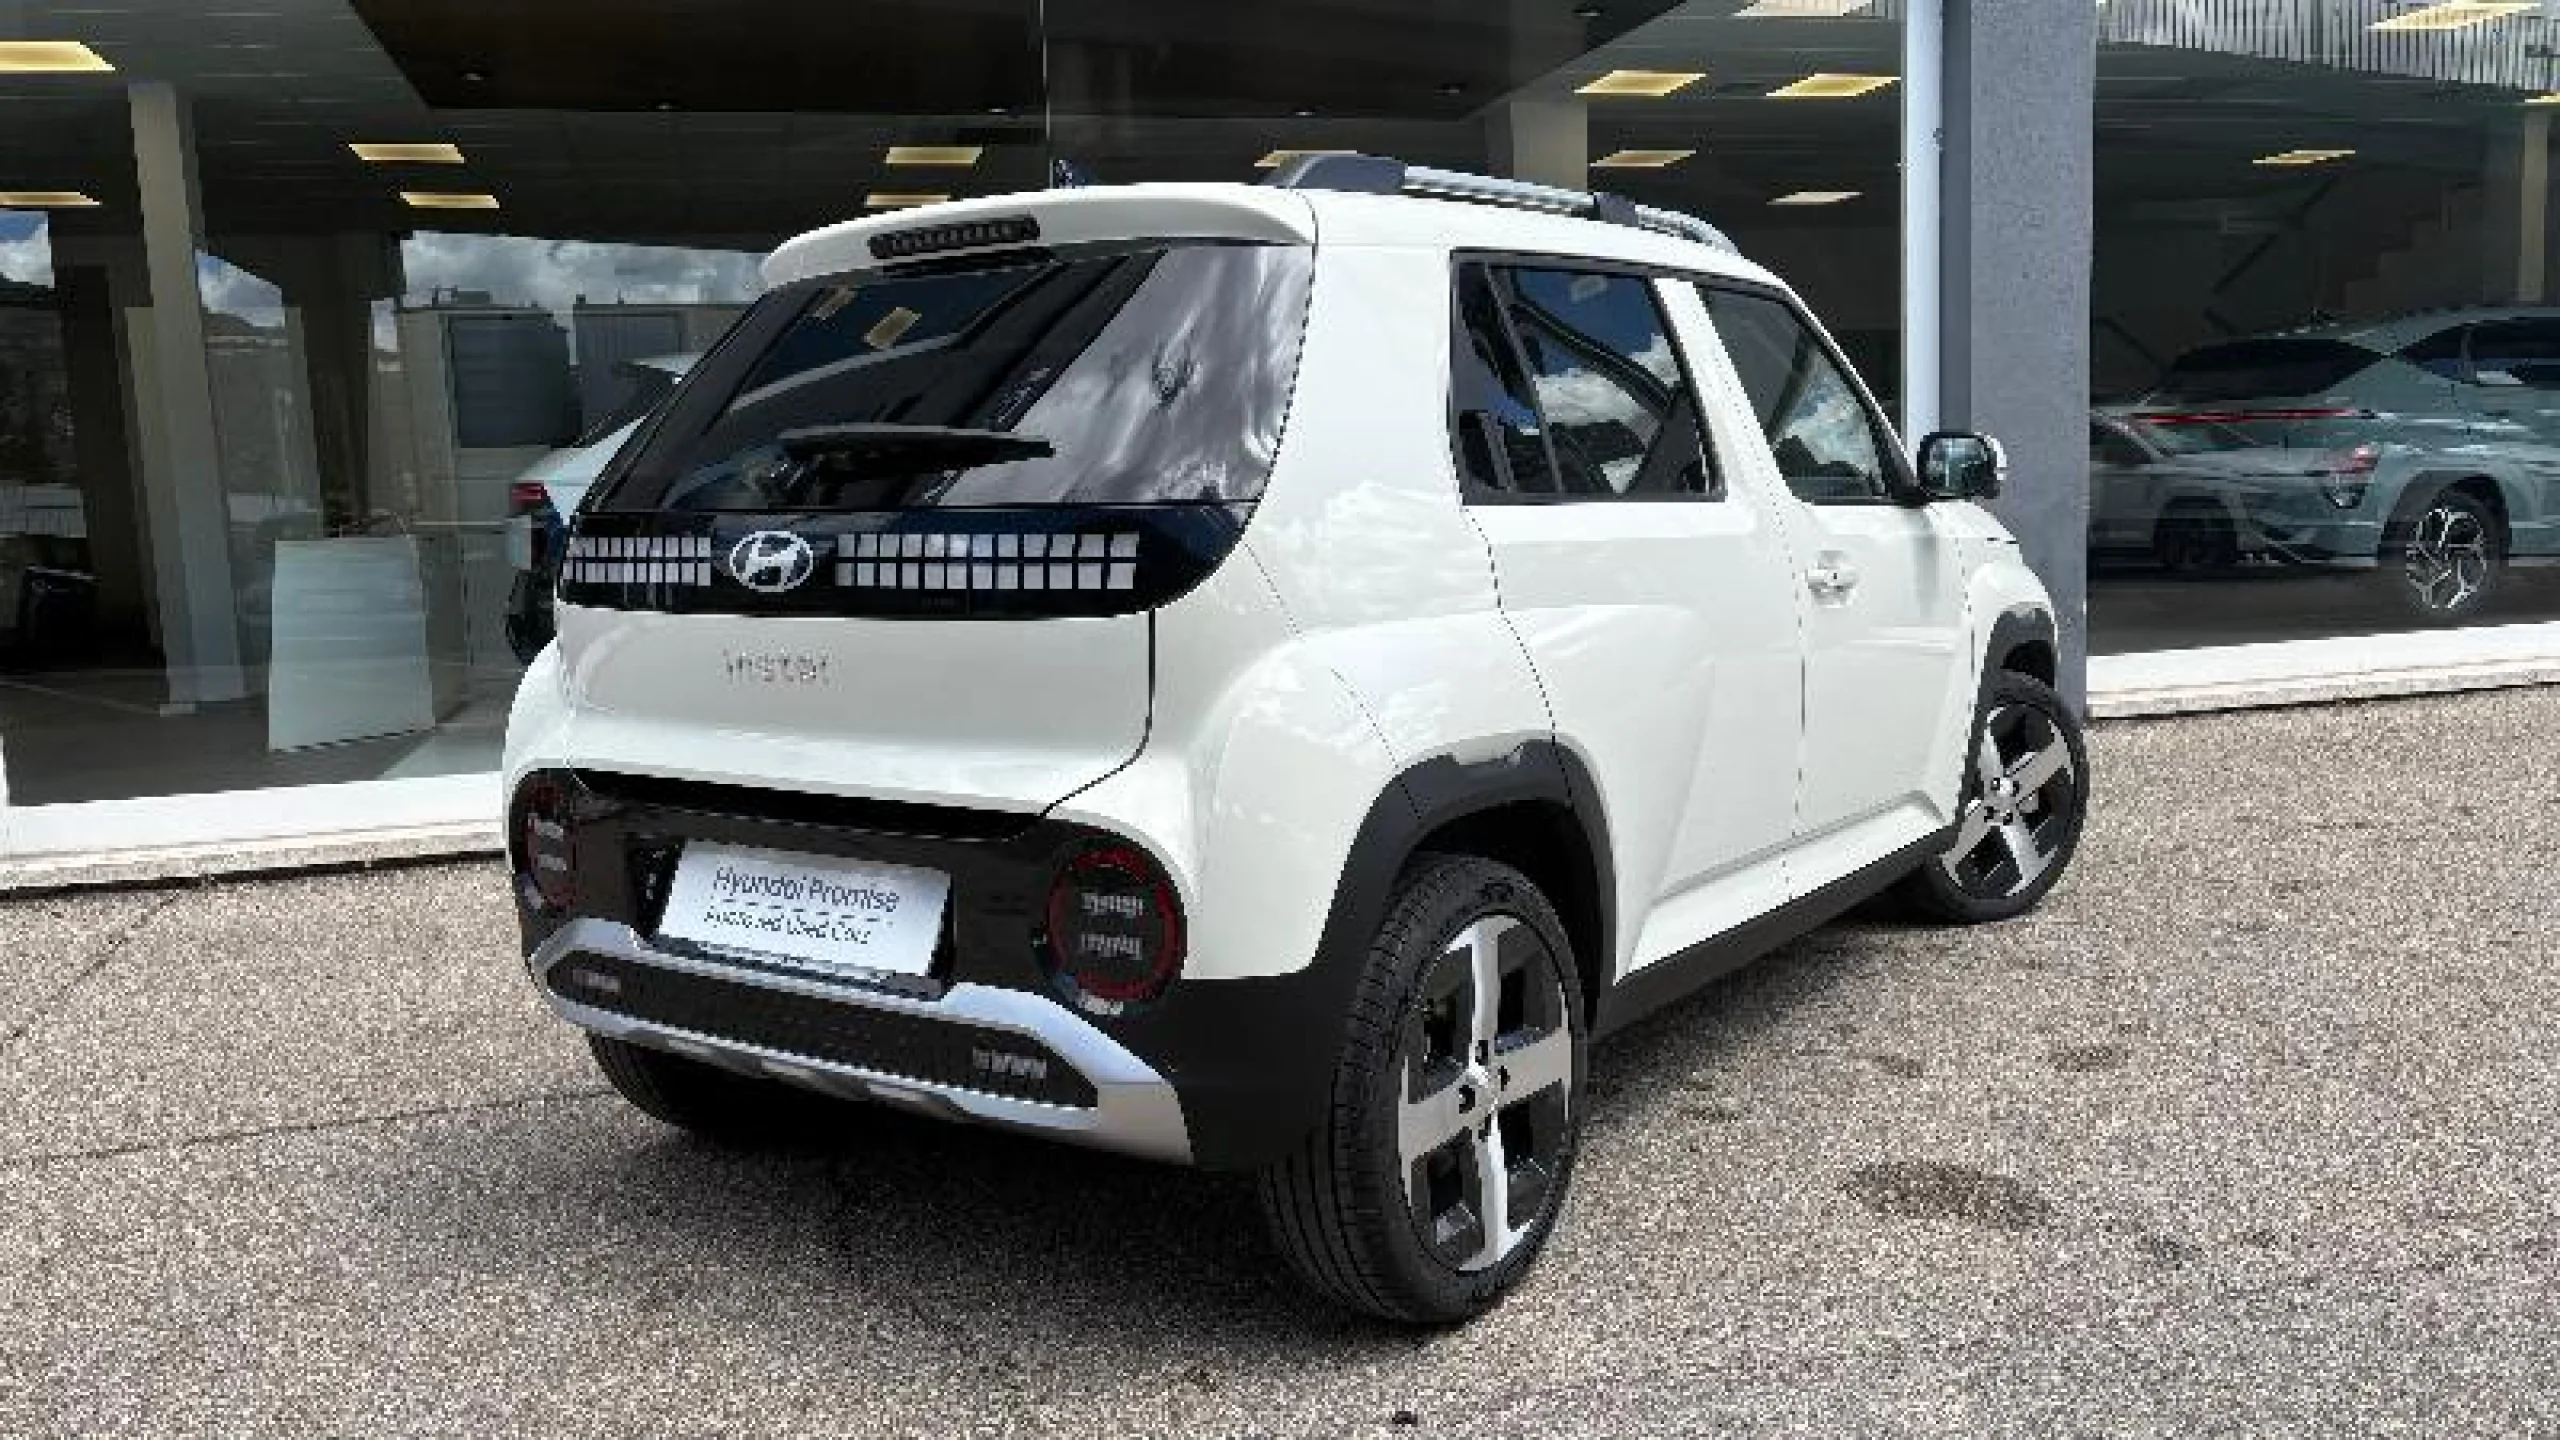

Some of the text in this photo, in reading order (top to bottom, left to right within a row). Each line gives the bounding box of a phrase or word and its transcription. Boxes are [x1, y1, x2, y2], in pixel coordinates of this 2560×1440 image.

[713, 866, 900, 913] Hyundai Promise
[787, 912, 829, 939] Used
